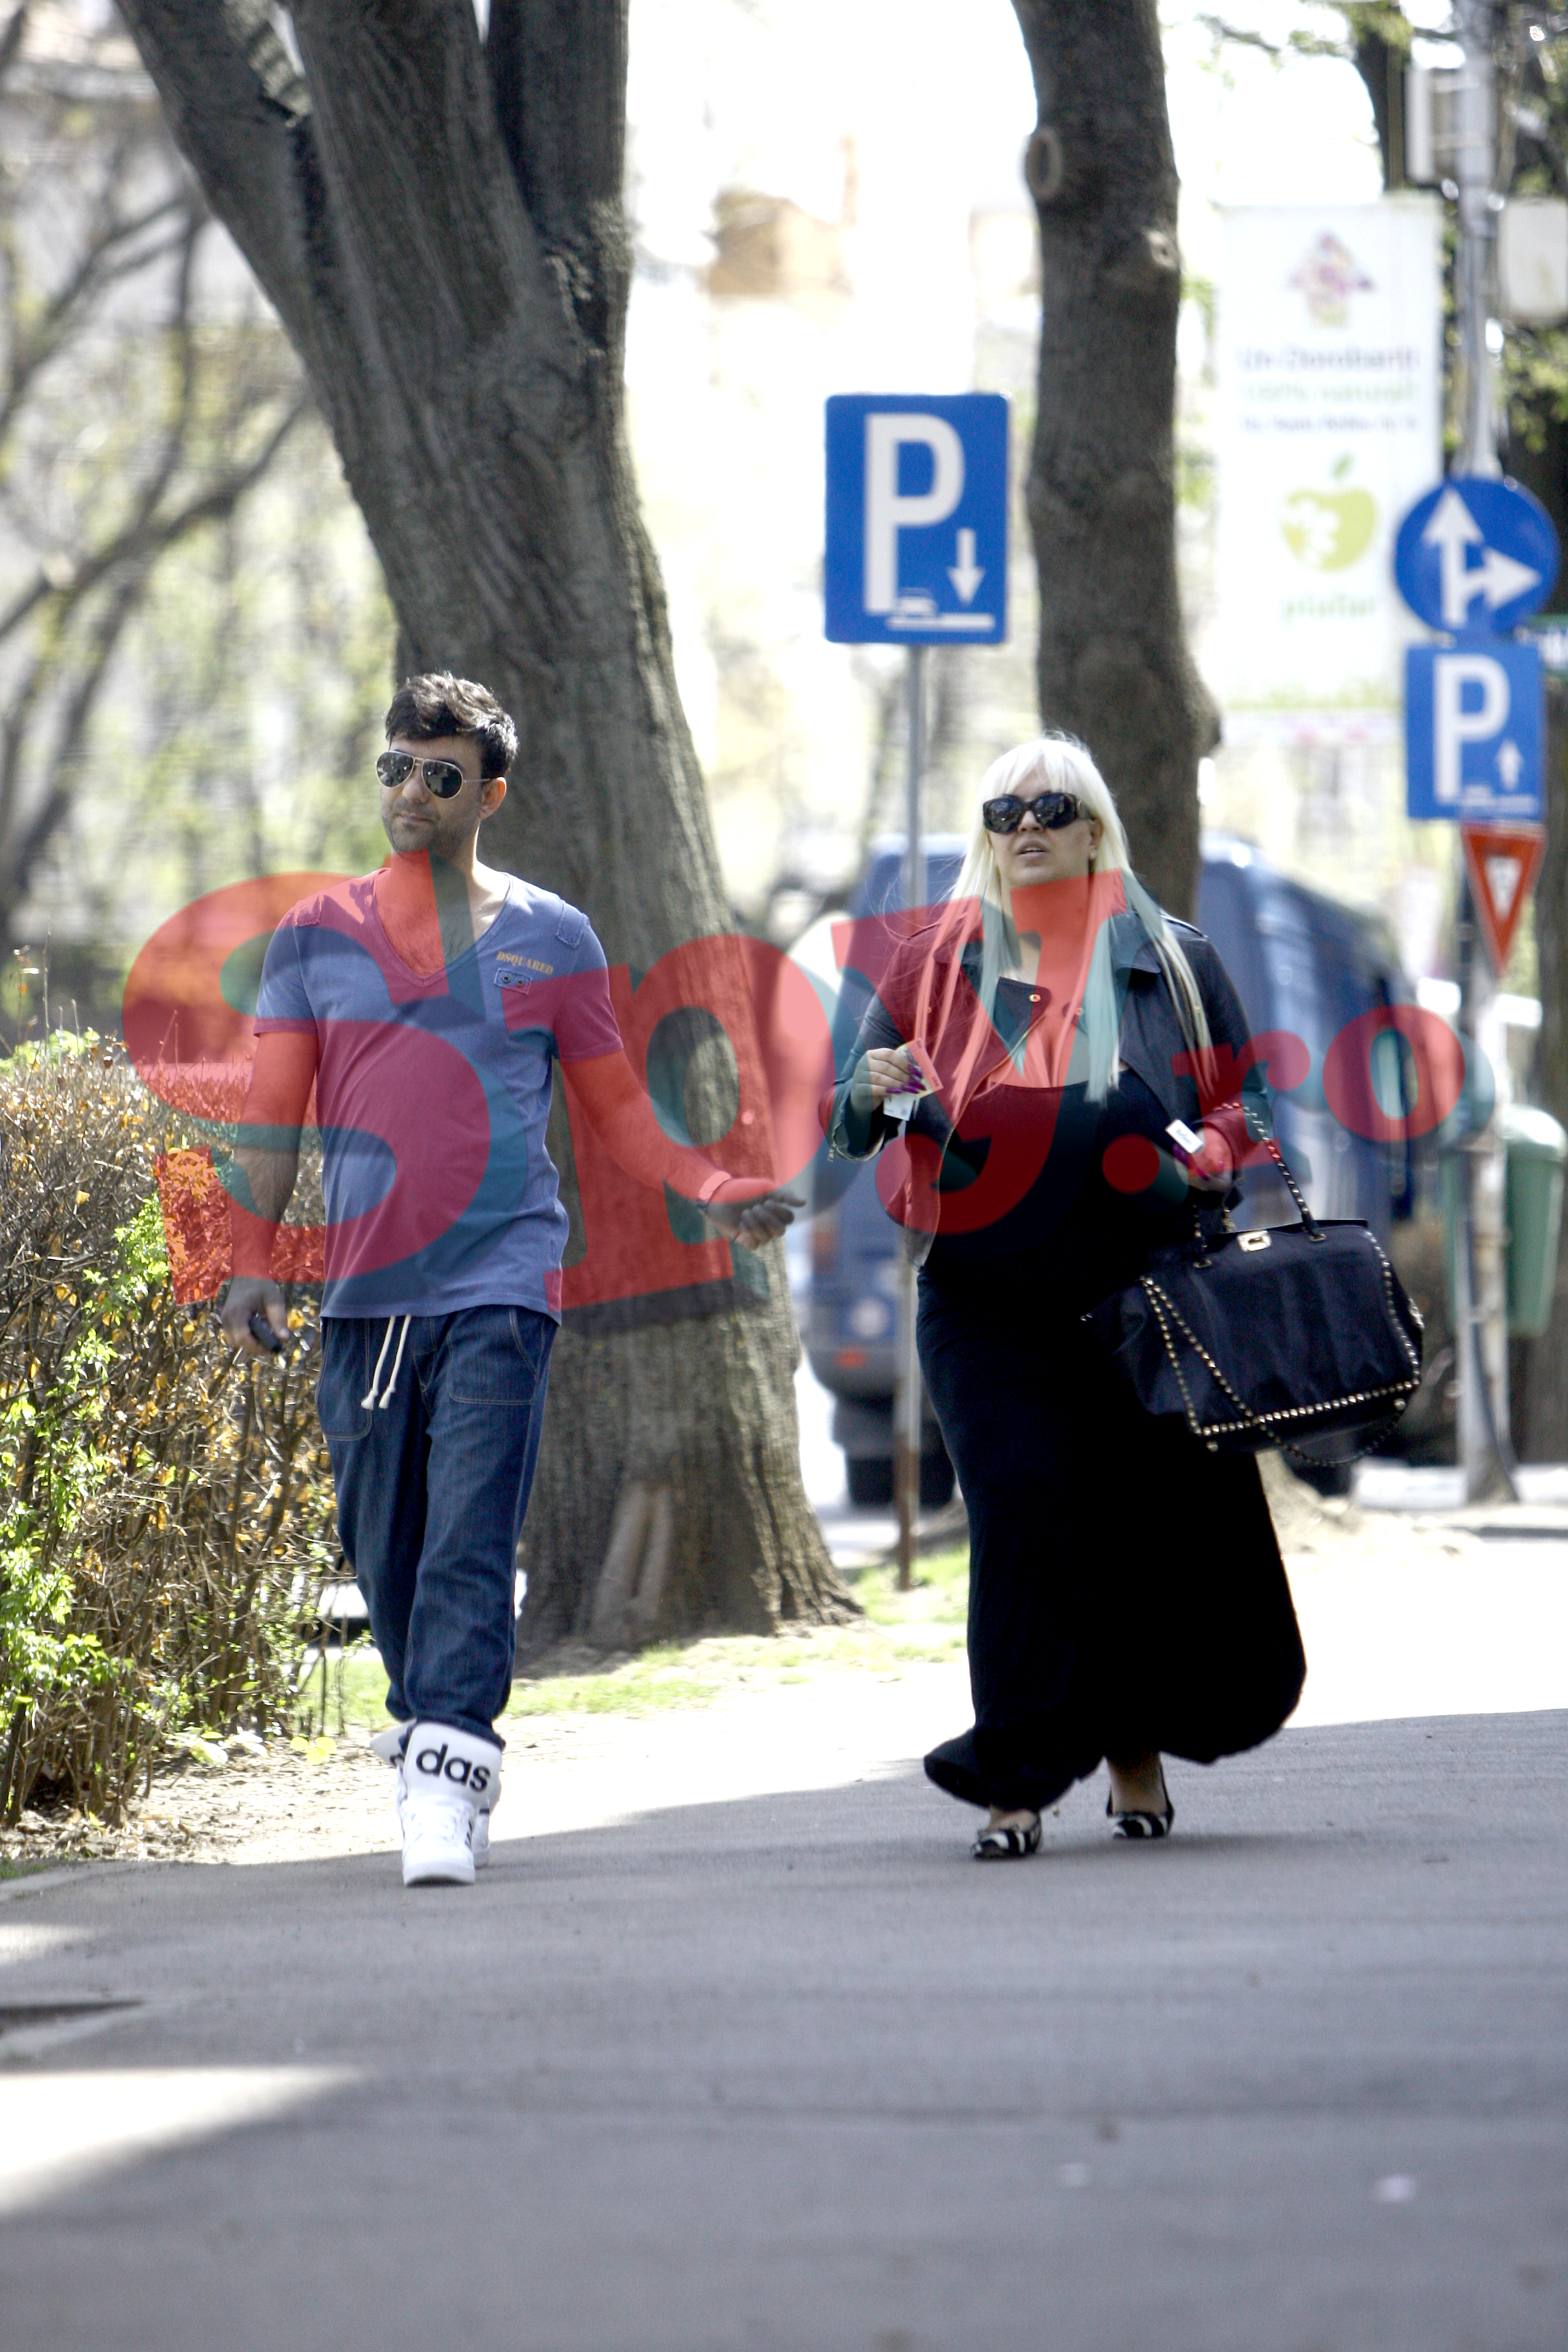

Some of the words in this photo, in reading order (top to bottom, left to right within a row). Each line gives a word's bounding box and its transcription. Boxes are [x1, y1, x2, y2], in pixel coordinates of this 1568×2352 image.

[865, 413, 965, 615] P
[1432, 653, 1510, 803] P
[495, 950, 554, 975] DSQUARED
[416, 1742, 491, 1792] das
